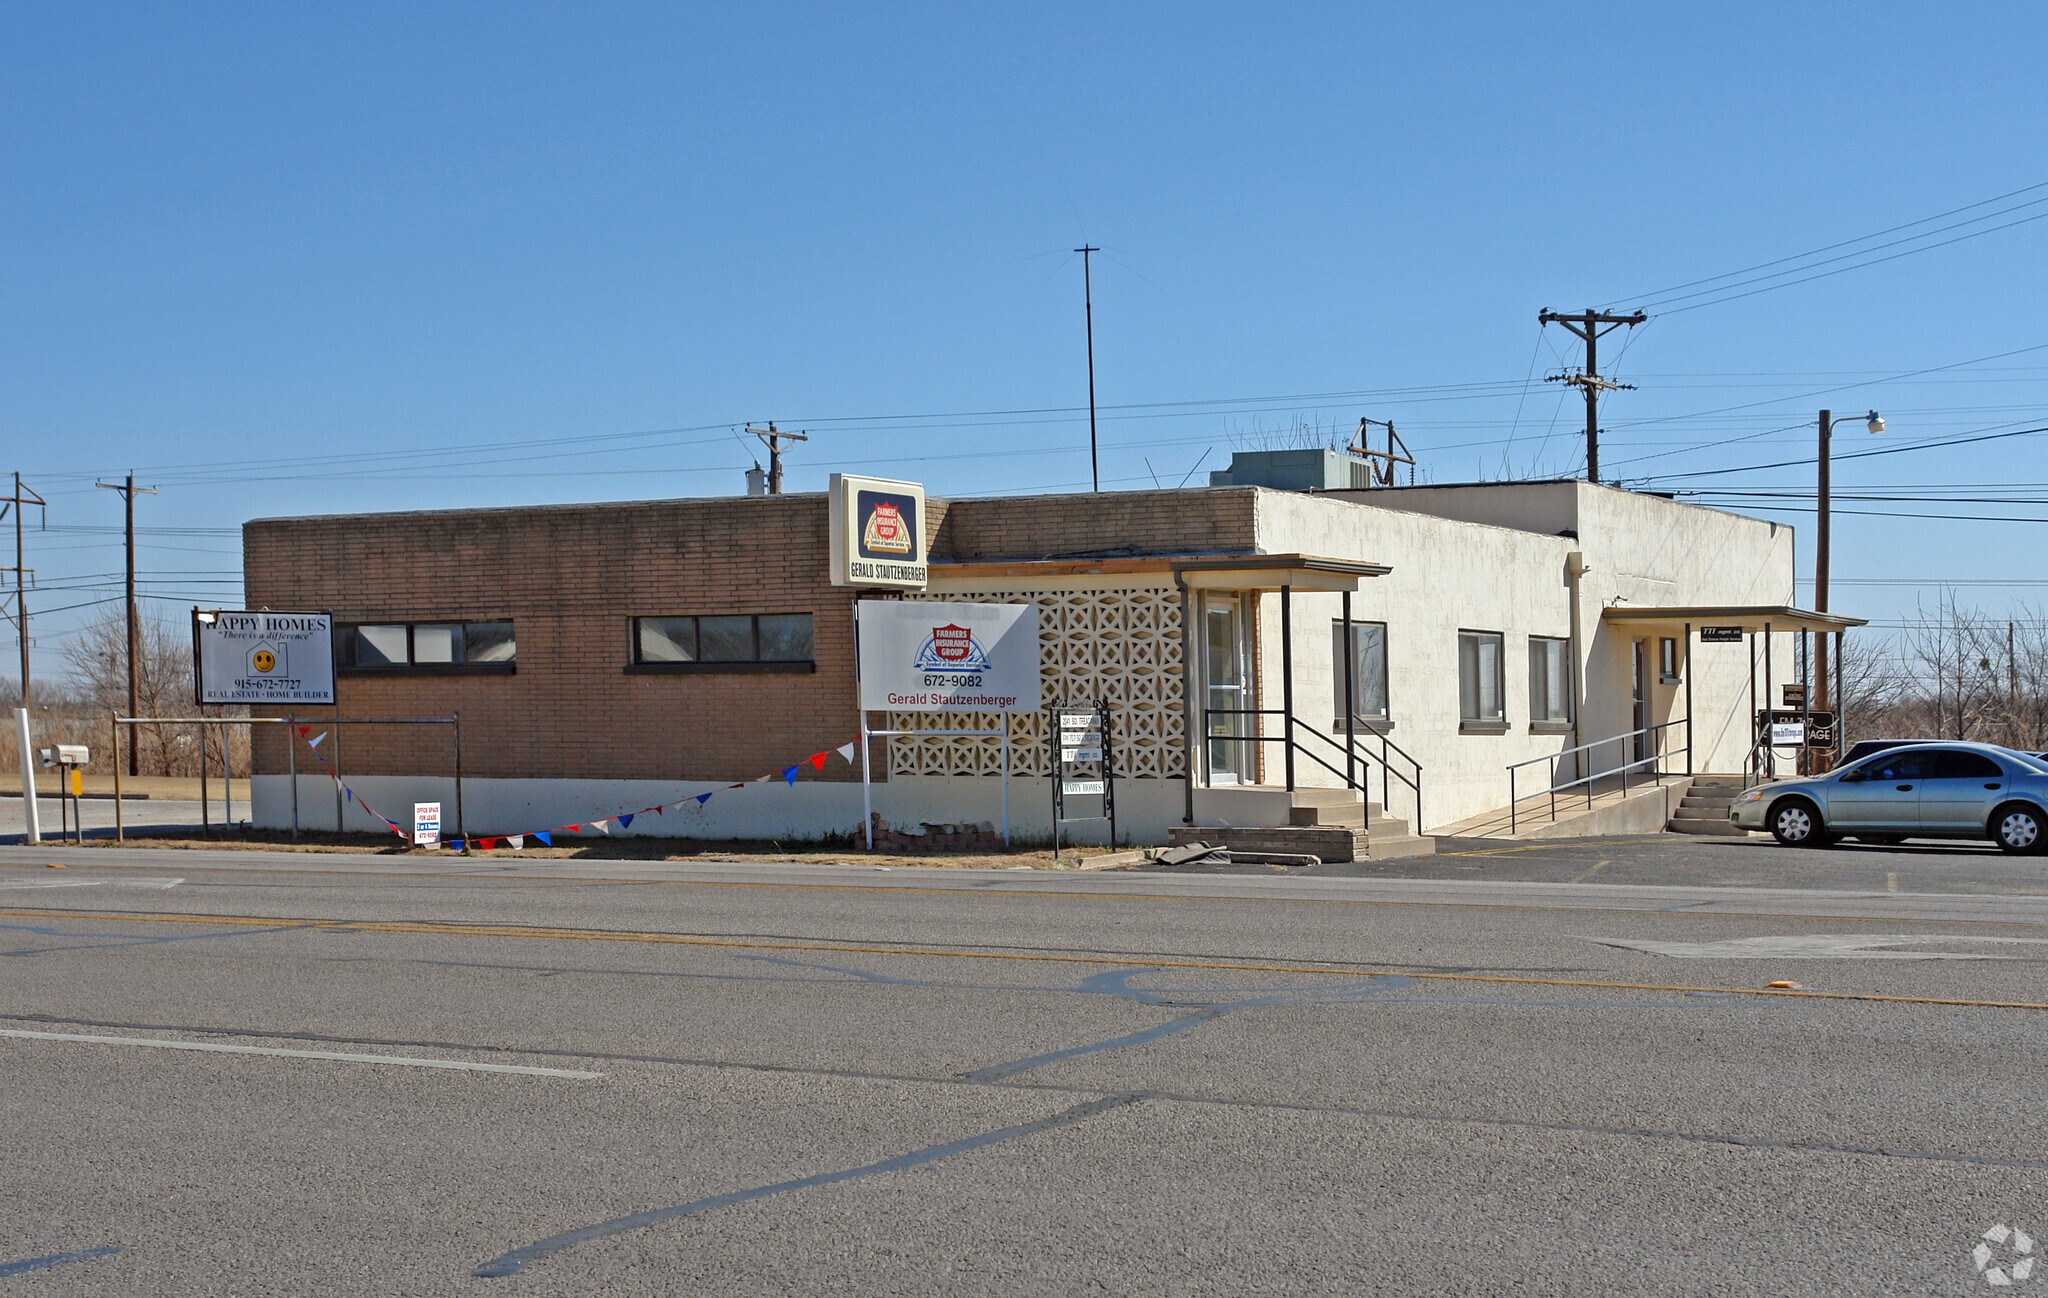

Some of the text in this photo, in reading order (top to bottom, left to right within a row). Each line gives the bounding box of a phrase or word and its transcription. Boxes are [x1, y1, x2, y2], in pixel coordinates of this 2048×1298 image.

[877, 507, 896, 517] FARMERS
[876, 517, 897, 526] INSURANCE
[880, 527, 894, 536] GROUP
[851, 562, 926, 581] GERALD STAUTZENBERGER
[267, 618, 326, 631] HOMES
[249, 631, 257, 639] is
[936, 630, 967, 639] FARMERS
[935, 639, 969, 648] INSURANCE
[941, 648, 964, 657] GROUP
[234, 679, 301, 690] 915-672-7727
[924, 675, 982, 687] 672-9082
[207, 690, 329, 699] REAL ESTATE HOME BUILDER
[887, 692, 1017, 708] Gerald Stautzenberger
[1065, 782, 1102, 793] HAPPY HOMES
